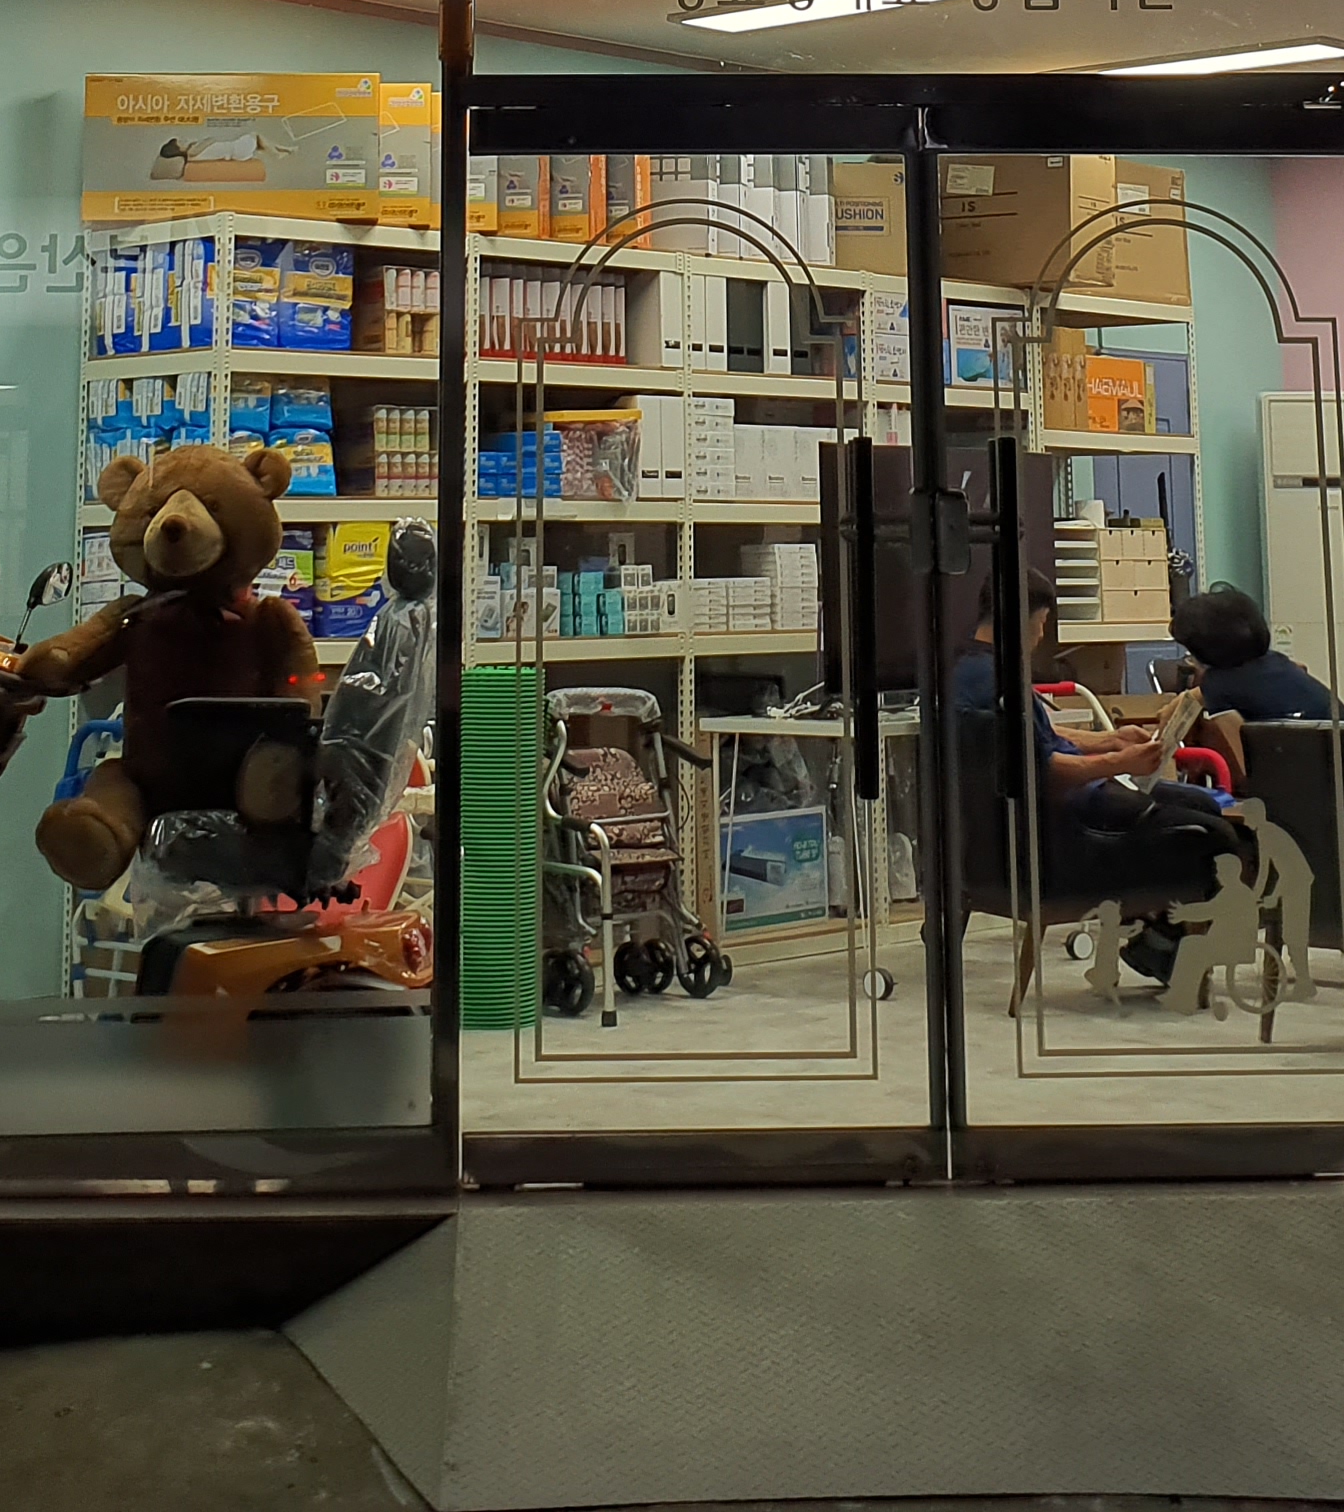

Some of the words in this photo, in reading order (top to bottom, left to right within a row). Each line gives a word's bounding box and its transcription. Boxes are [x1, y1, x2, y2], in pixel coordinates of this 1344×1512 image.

[116, 93, 171, 114] 아시아
[175, 92, 281, 114] 자세변환용구
[835, 208, 884, 220] USHION
